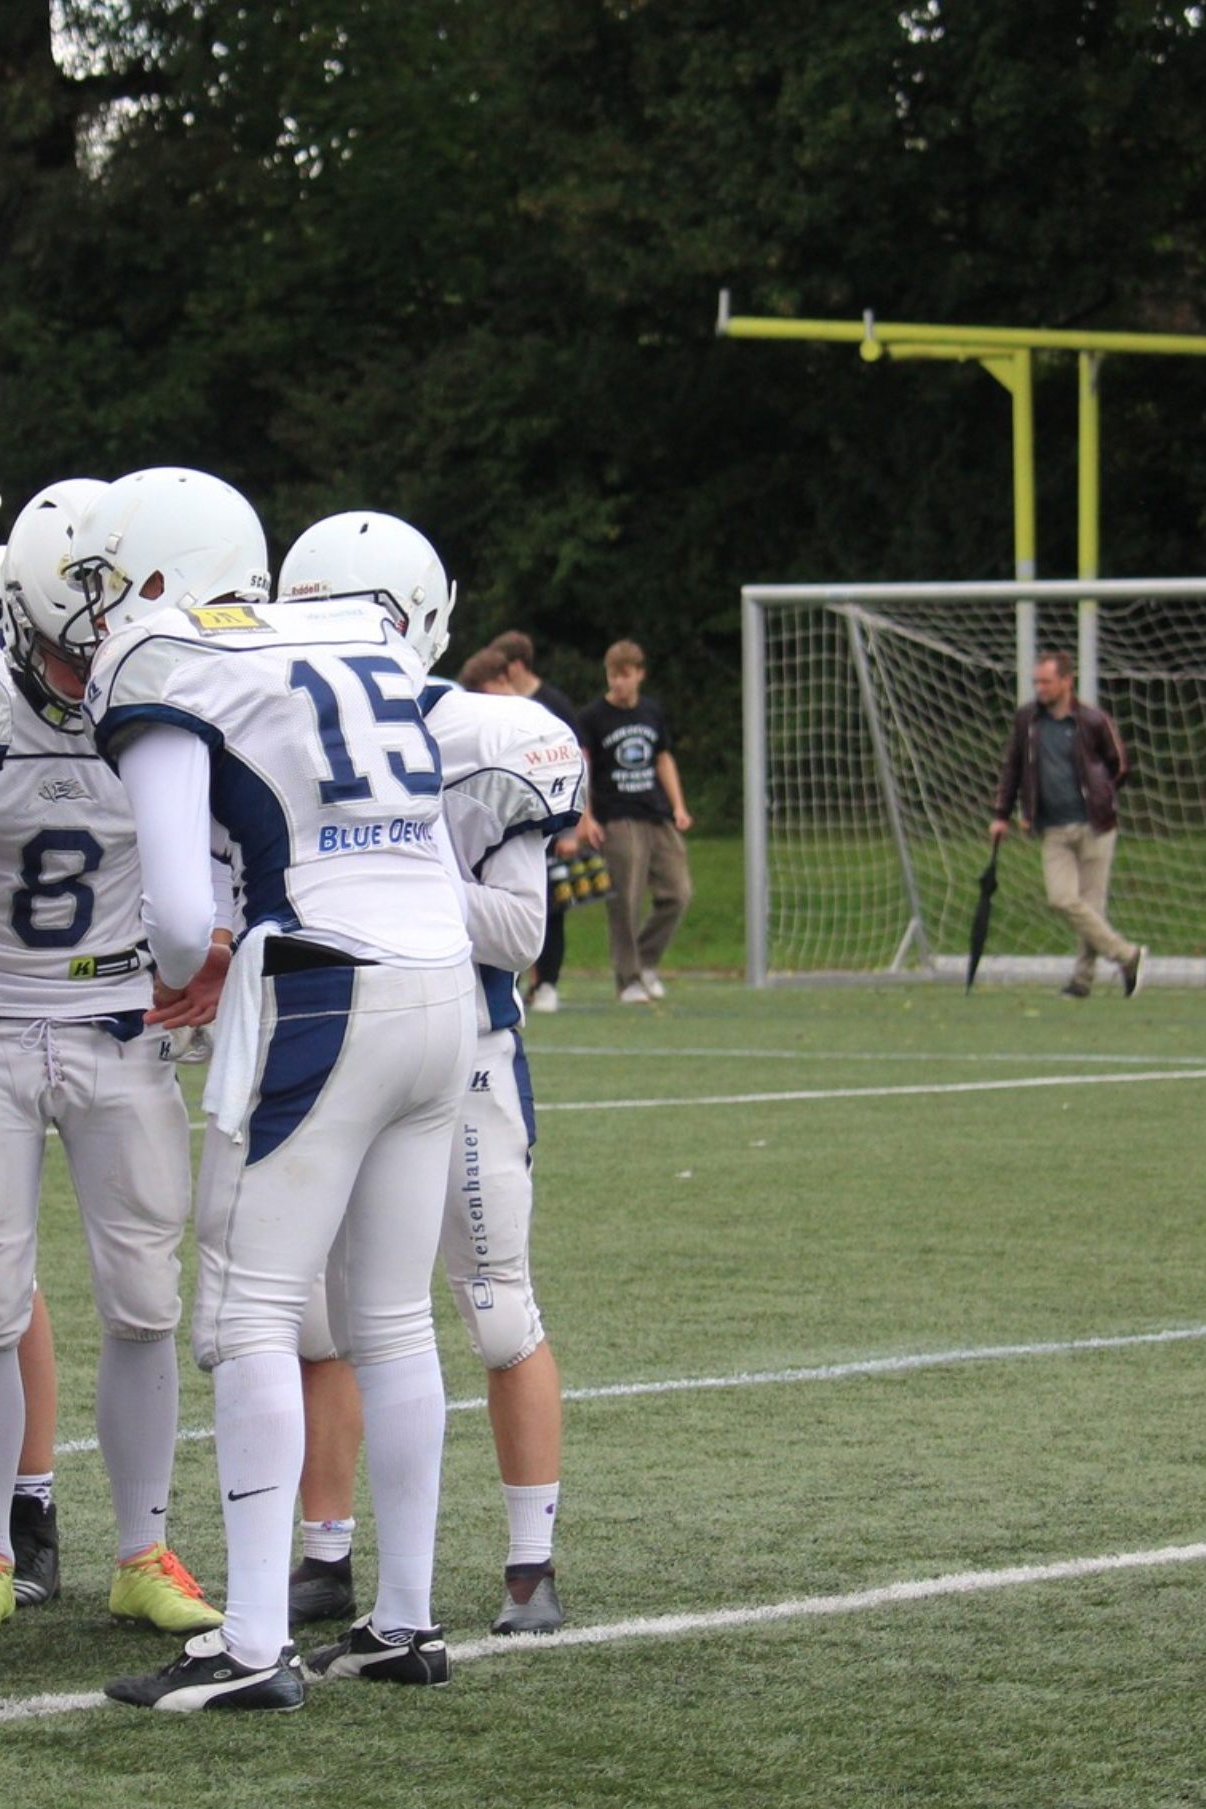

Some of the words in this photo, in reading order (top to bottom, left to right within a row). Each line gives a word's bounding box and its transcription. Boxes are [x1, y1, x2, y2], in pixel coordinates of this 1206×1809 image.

[288, 656, 443, 804] 15
[11, 829, 105, 948] 8
[319, 825, 382, 852] BLUE
